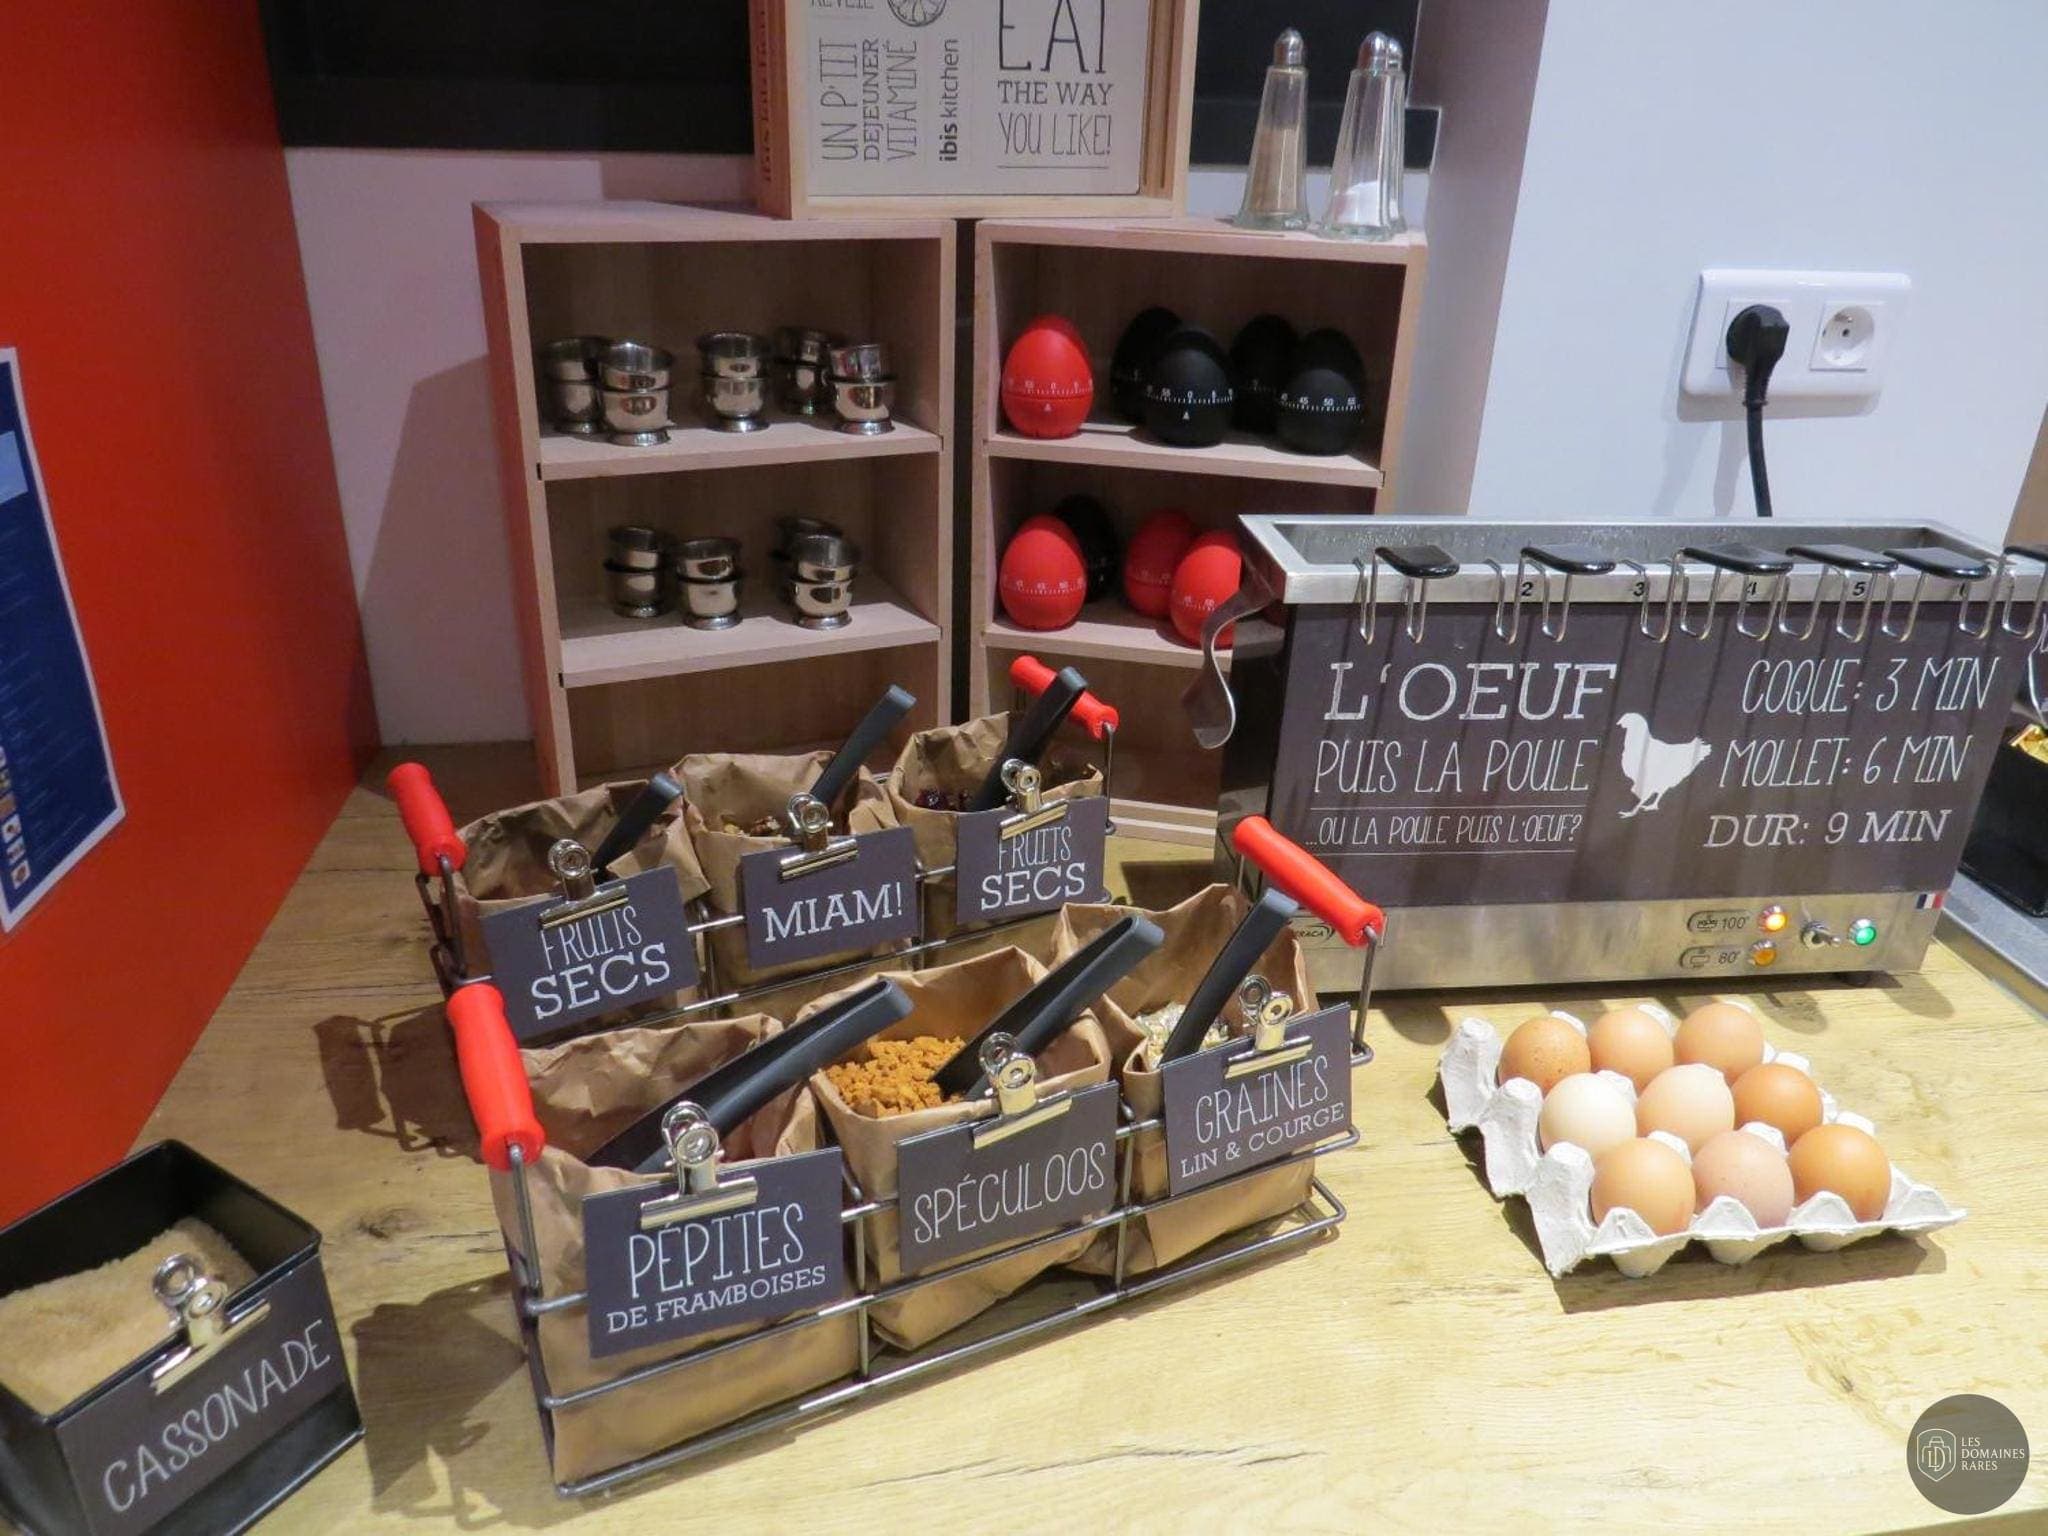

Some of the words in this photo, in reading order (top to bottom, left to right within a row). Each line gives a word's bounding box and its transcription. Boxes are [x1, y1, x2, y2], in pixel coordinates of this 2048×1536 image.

[862, 38, 884, 162] DEJEUNER
[940, 39, 960, 118] kitchen
[997, 80, 1048, 105] THE
[1056, 82, 1114, 106] WAY
[822, 122, 859, 161] UN
[939, 123, 958, 162] ibis
[998, 112, 1042, 155] YOU
[1052, 114, 1112, 156] LIKE!
[1521, 581, 1534, 597] 2
[1632, 581, 1646, 597] 3
[1852, 581, 1866, 597] 5
[1323, 662, 1618, 721] L'OEUF
[1742, 657, 1864, 715] COQUE:
[1875, 658, 1908, 711] 3
[1911, 656, 2000, 711] MIN
[1313, 739, 1402, 793] PUIS
[1414, 740, 1463, 793] LA
[1482, 739, 1599, 793] POULE
[1719, 737, 1852, 787] MOLLET:
[1863, 736, 1887, 785] 6
[1893, 734, 1974, 784] MIN
[997, 825, 1073, 871] FRUITS
[1351, 816, 1379, 845] LA
[1388, 815, 1451, 845] POULE
[1455, 815, 1503, 844] PUIS
[1703, 813, 1810, 848] DUR:
[1824, 811, 1849, 844] 9
[1858, 808, 1953, 843] MIN
[762, 881, 903, 943] MIAM!
[981, 862, 1086, 911] SECS
[539, 905, 643, 971] FRUITS
[531, 942, 671, 1020] SECS
[1195, 1055, 1329, 1144] GRAINES
[1180, 1148, 1218, 1179] LIN
[1225, 1141, 1241, 1161] &
[1248, 1102, 1345, 1152] COURGE
[914, 1142, 1106, 1244] SPÉCULOOS
[607, 1305, 648, 1334] DE
[655, 1265, 827, 1323] FRAMBOISES
[103, 1319, 331, 1512] CASSONADE
